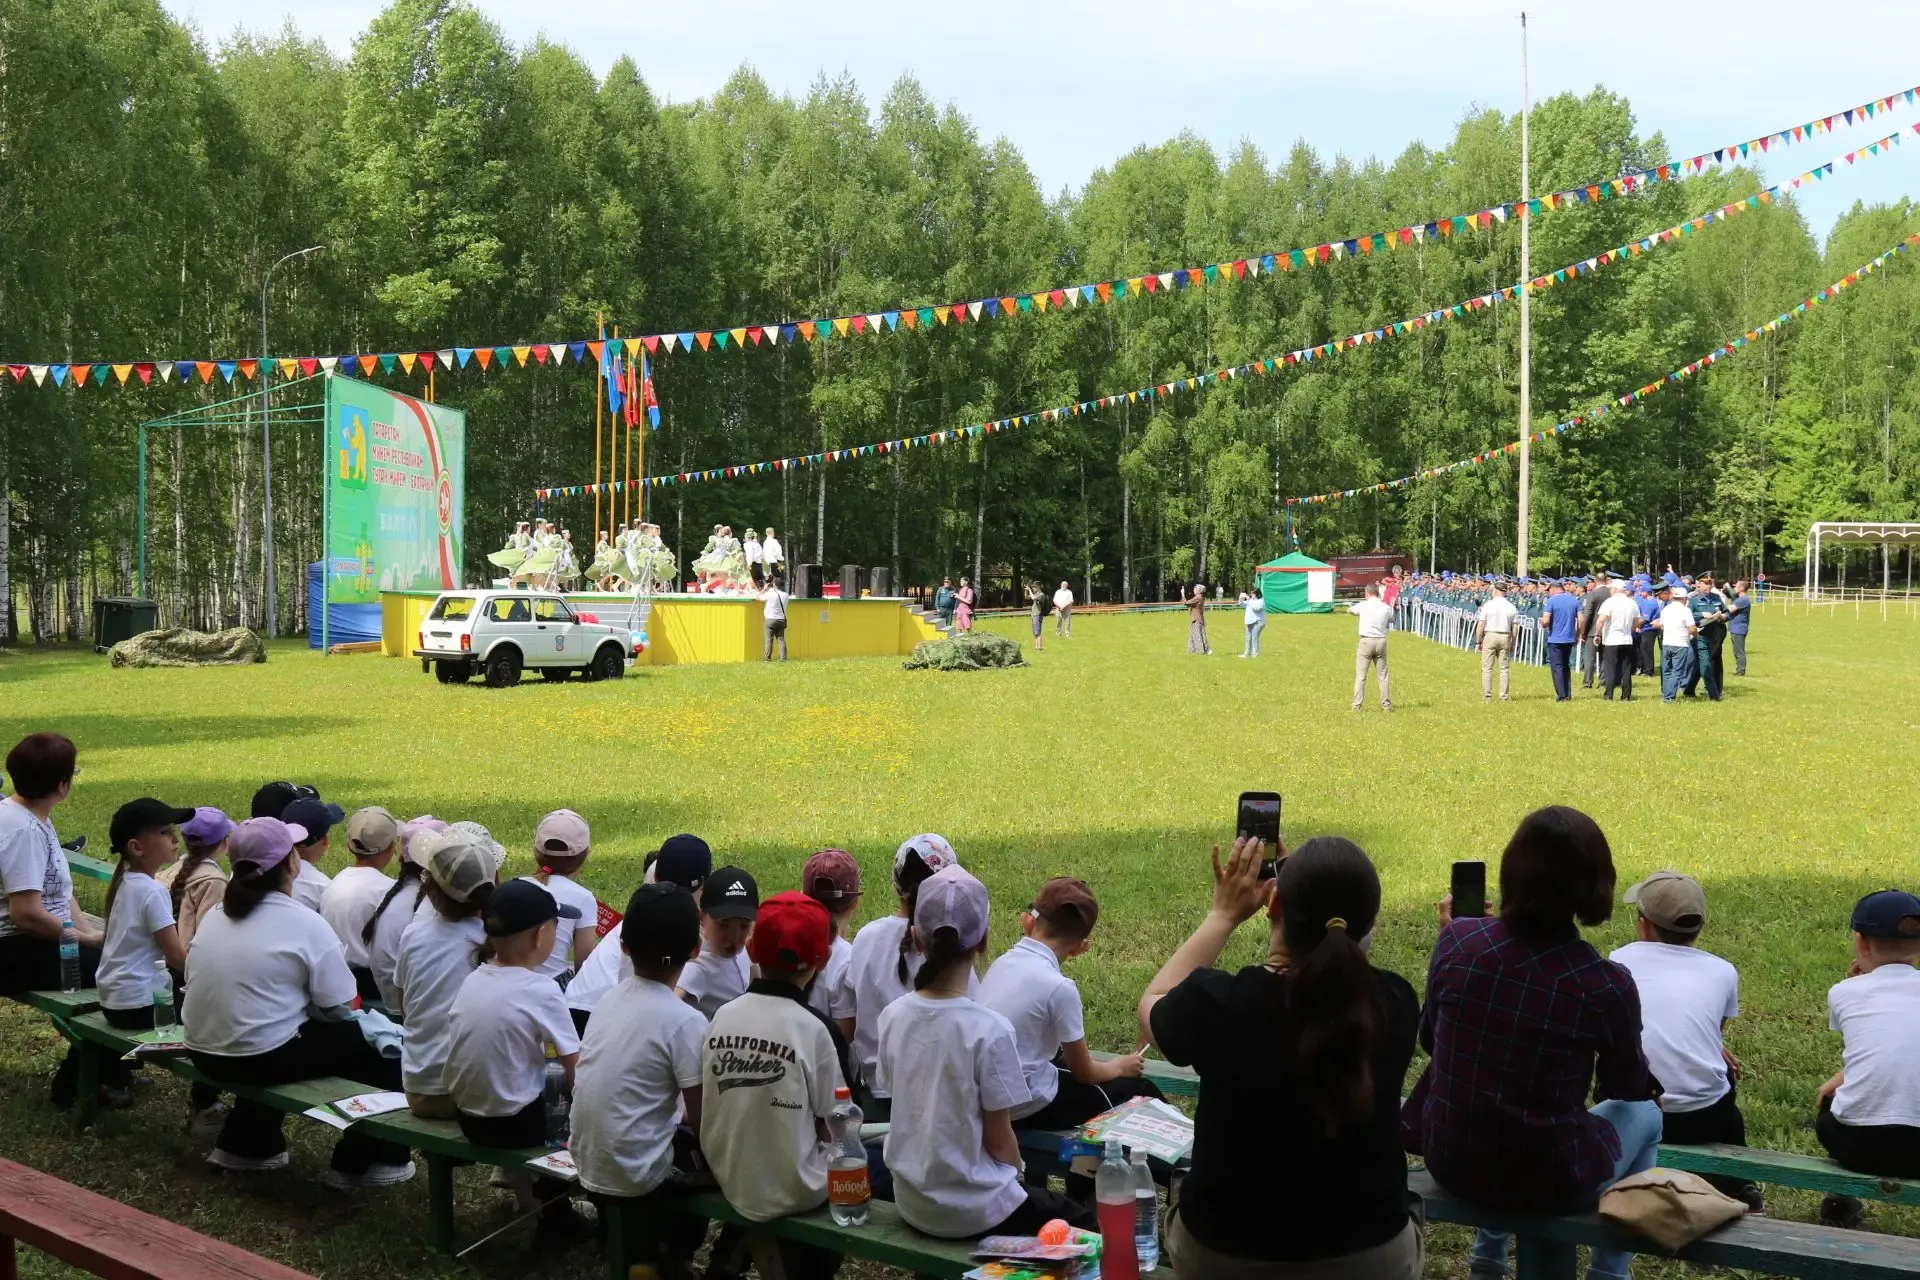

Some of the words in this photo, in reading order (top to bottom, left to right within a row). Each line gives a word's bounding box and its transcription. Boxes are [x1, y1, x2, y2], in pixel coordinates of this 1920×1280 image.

[709, 1035, 796, 1064] CALIFORNIA
[712, 1051, 786, 1077] Striker
[770, 1097, 803, 1110] Division
